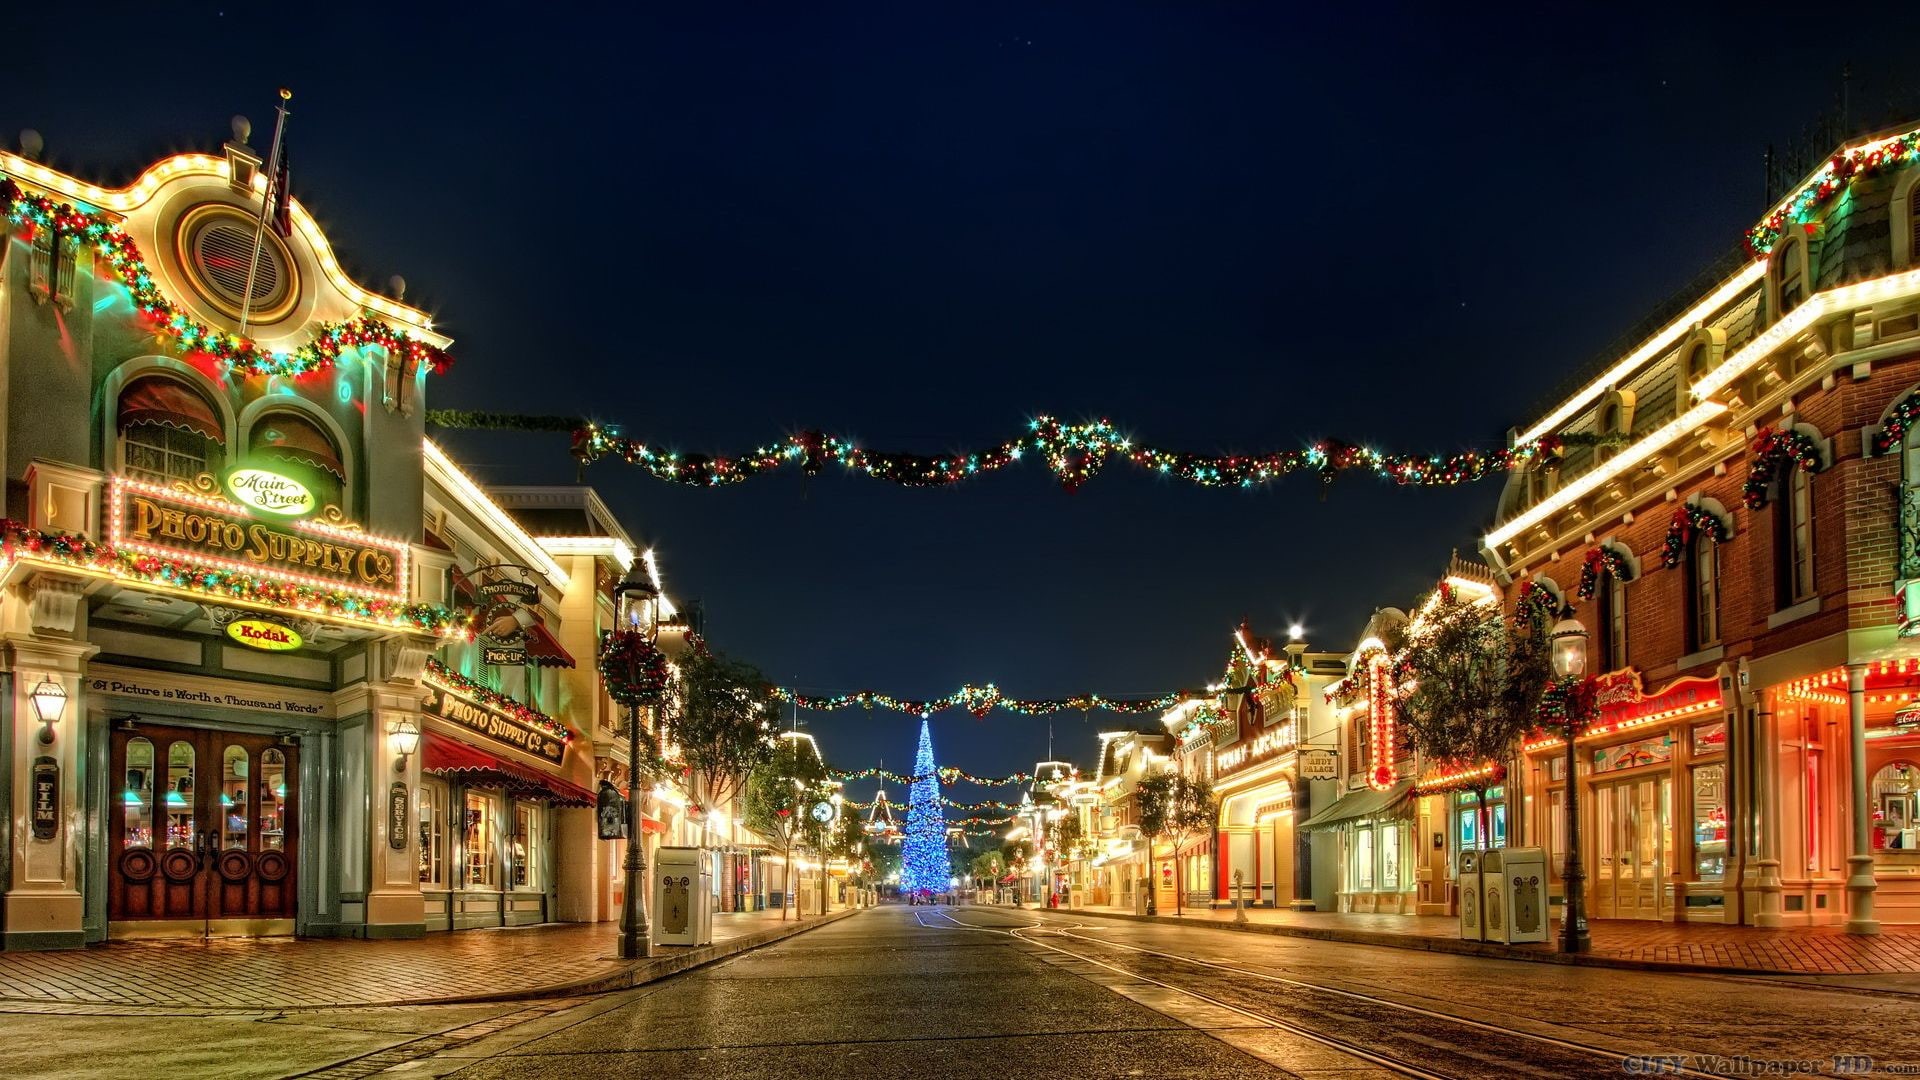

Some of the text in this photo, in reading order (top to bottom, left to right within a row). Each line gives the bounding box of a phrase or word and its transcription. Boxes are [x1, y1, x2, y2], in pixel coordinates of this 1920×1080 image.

[233, 474, 298, 493] Main
[254, 489, 308, 509] Street
[134, 497, 245, 551] PHOTO
[245, 524, 355, 574] SUPPLY
[241, 625, 290, 643] Kodak
[111, 681, 160, 697] Picture
[163, 688, 174, 698] is
[175, 689, 211, 702] Worth
[213, 696, 222, 704] a
[225, 695, 281, 711] Thousand
[440, 692, 489, 729] PHOTO
[489, 714, 528, 744] SUPPLY
[37, 782, 55, 820] FILM
[393, 797, 405, 839] SERVICE
